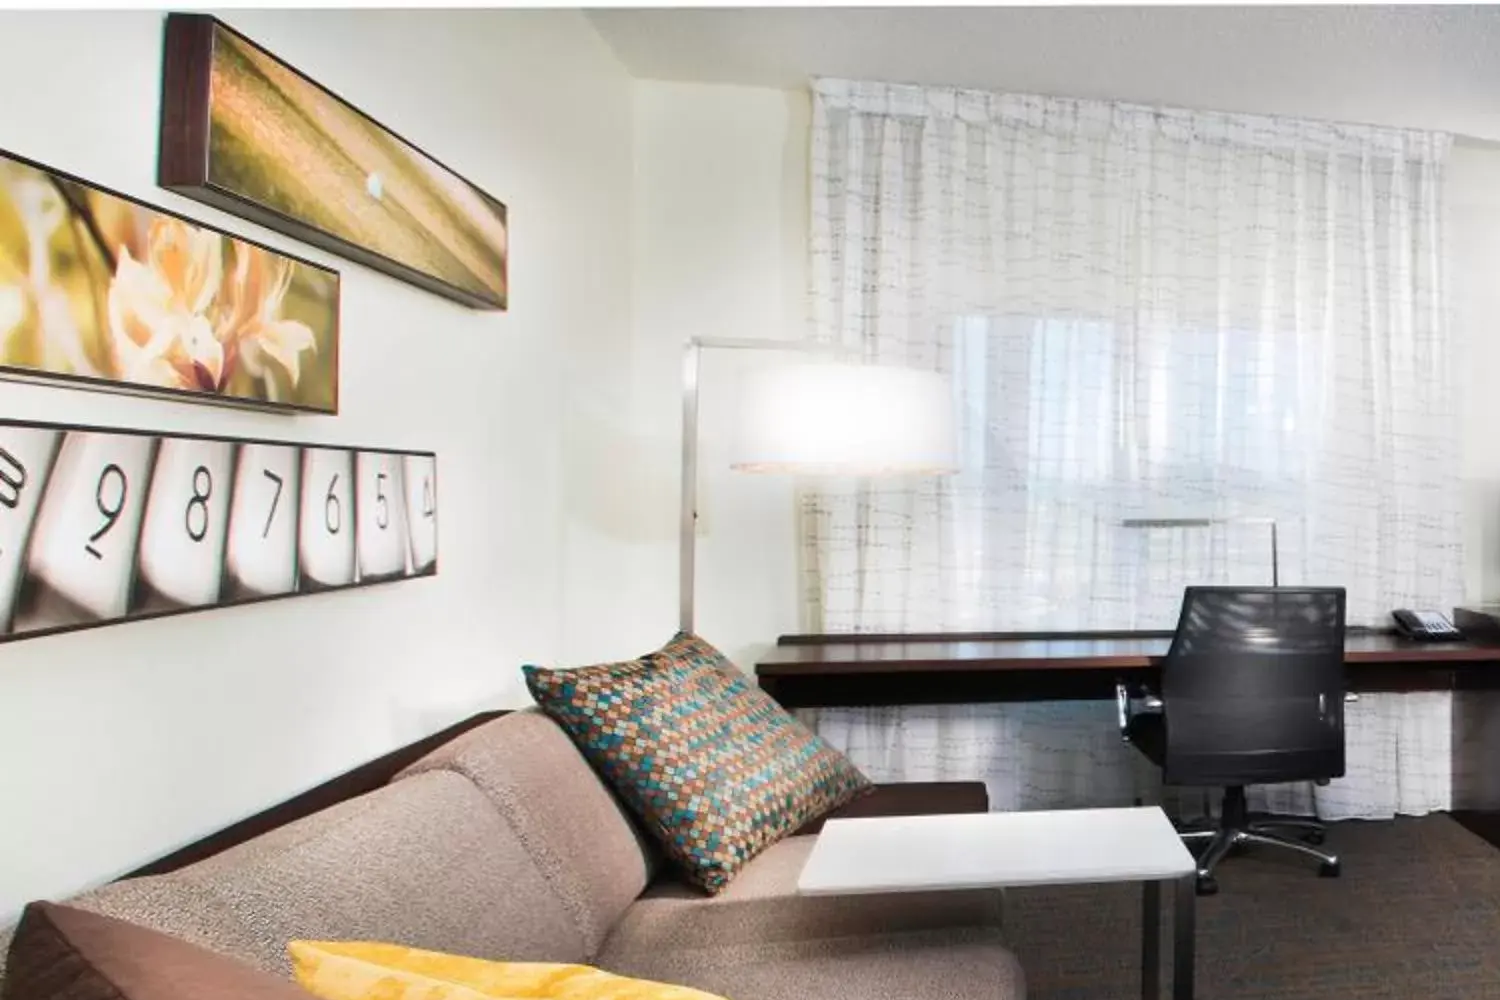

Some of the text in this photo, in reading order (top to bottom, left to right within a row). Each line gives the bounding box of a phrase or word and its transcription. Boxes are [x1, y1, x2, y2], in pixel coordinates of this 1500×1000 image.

[89, 463, 127, 543] 9
[185, 465, 212, 541] 8
[263, 469, 283, 540] 7
[325, 473, 341, 534] 6
[376, 472, 388, 530] 5
